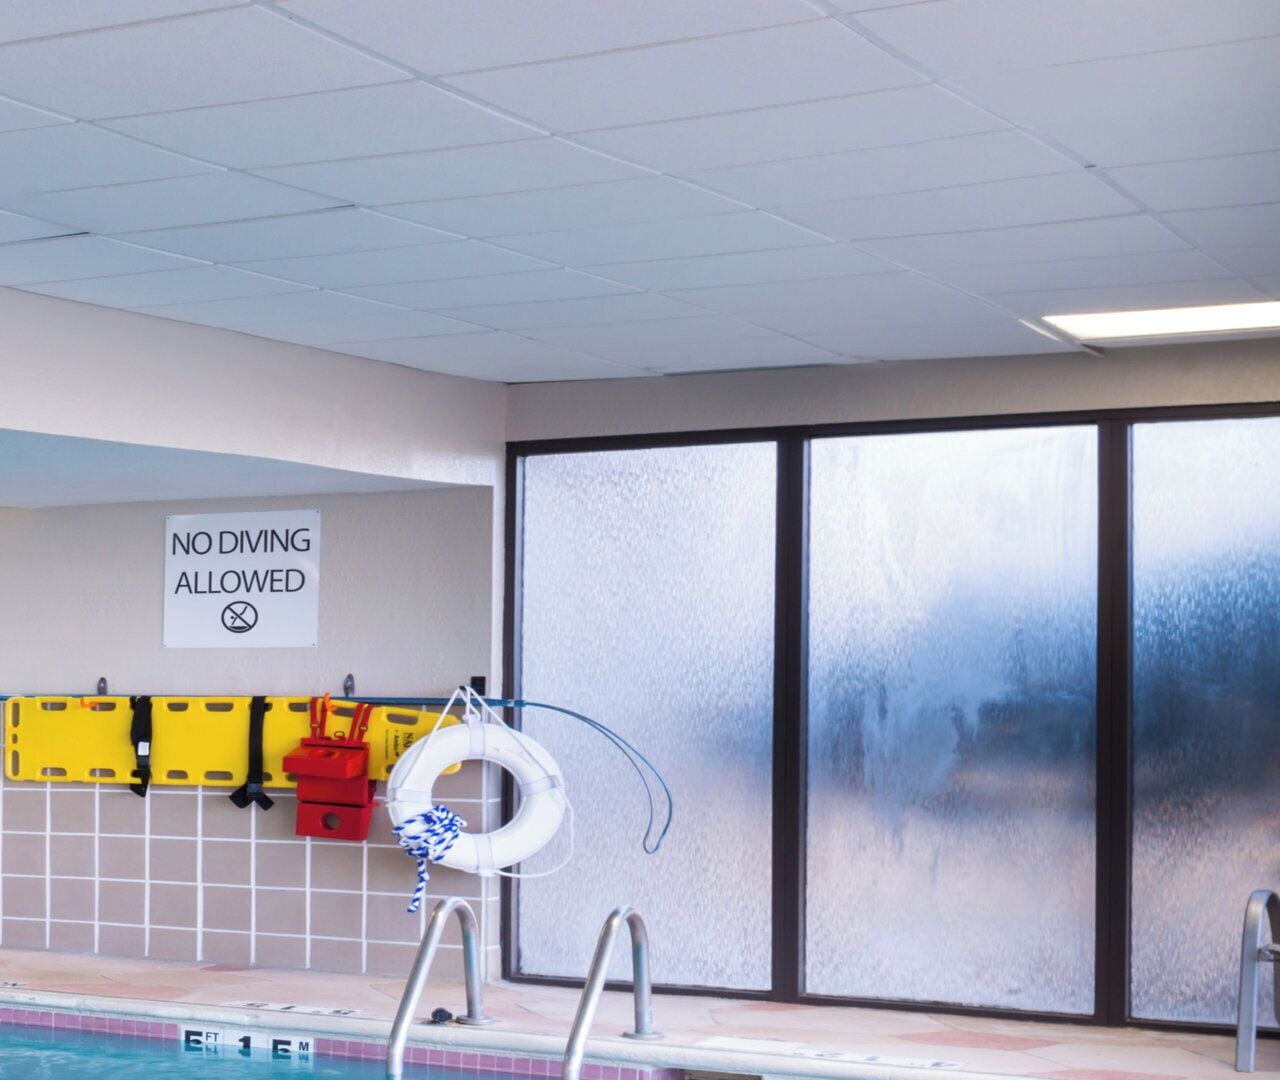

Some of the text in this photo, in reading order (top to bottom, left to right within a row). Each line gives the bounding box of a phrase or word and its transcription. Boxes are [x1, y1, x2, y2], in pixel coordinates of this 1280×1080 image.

[172, 528, 311, 555] NO DIVING
[174, 568, 306, 594] ALLOWED
